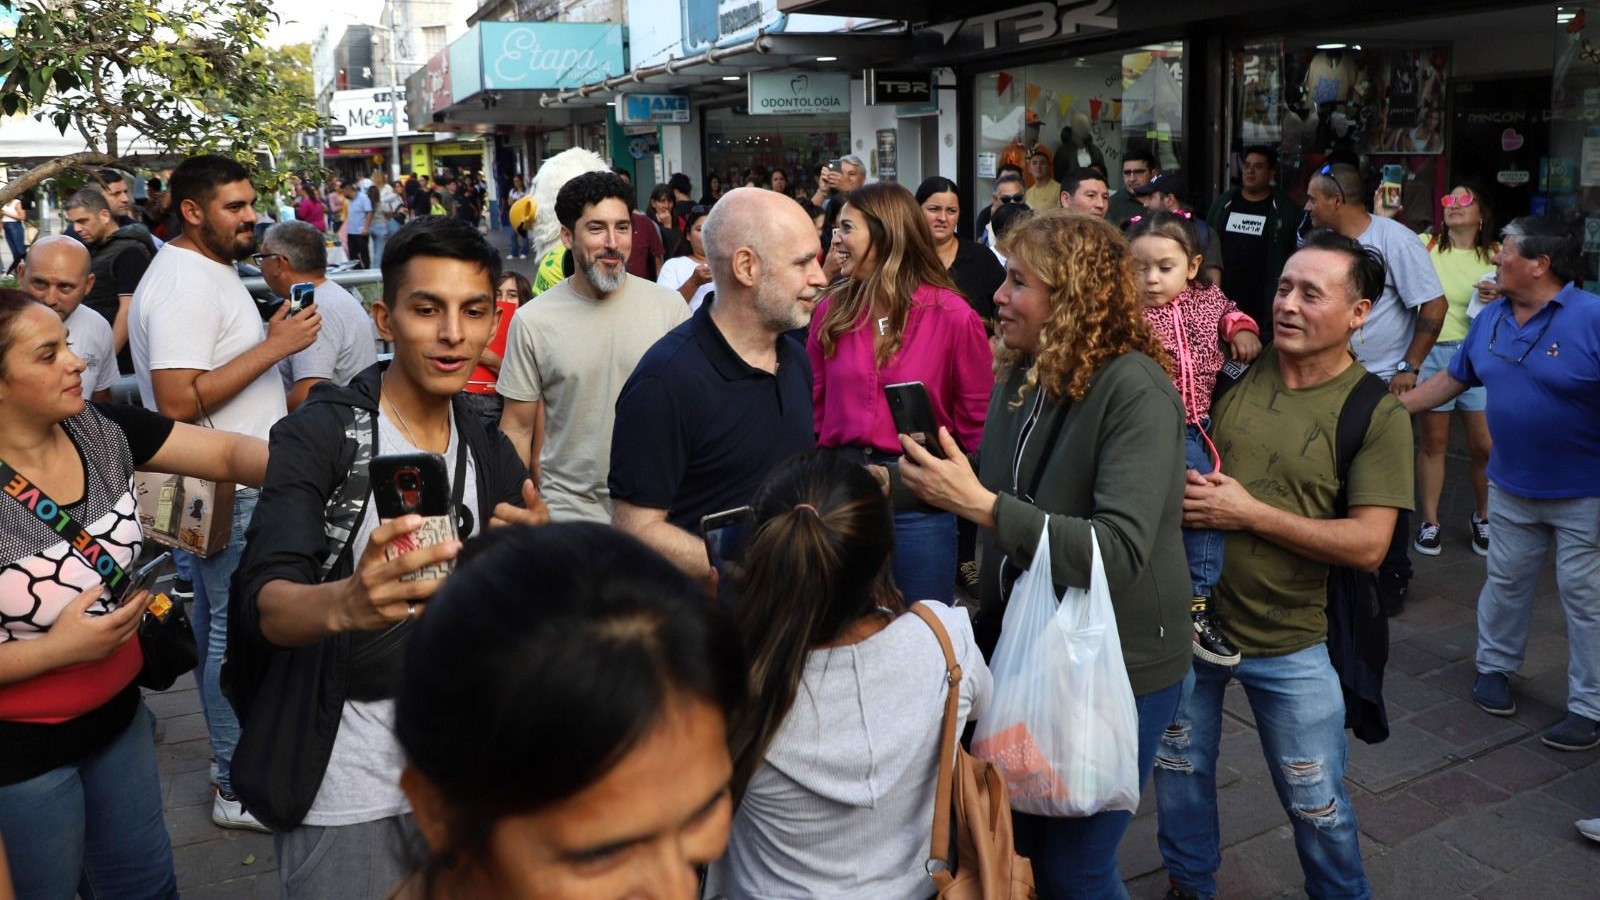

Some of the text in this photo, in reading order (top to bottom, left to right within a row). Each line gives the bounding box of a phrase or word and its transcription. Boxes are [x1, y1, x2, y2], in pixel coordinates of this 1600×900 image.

[495, 27, 598, 82] Etapa
[761, 95, 841, 107] ODONTOLOGÍA
[878, 316, 889, 336] F
[4, 474, 71, 533] LOVE
[72, 528, 125, 589] LOVE
